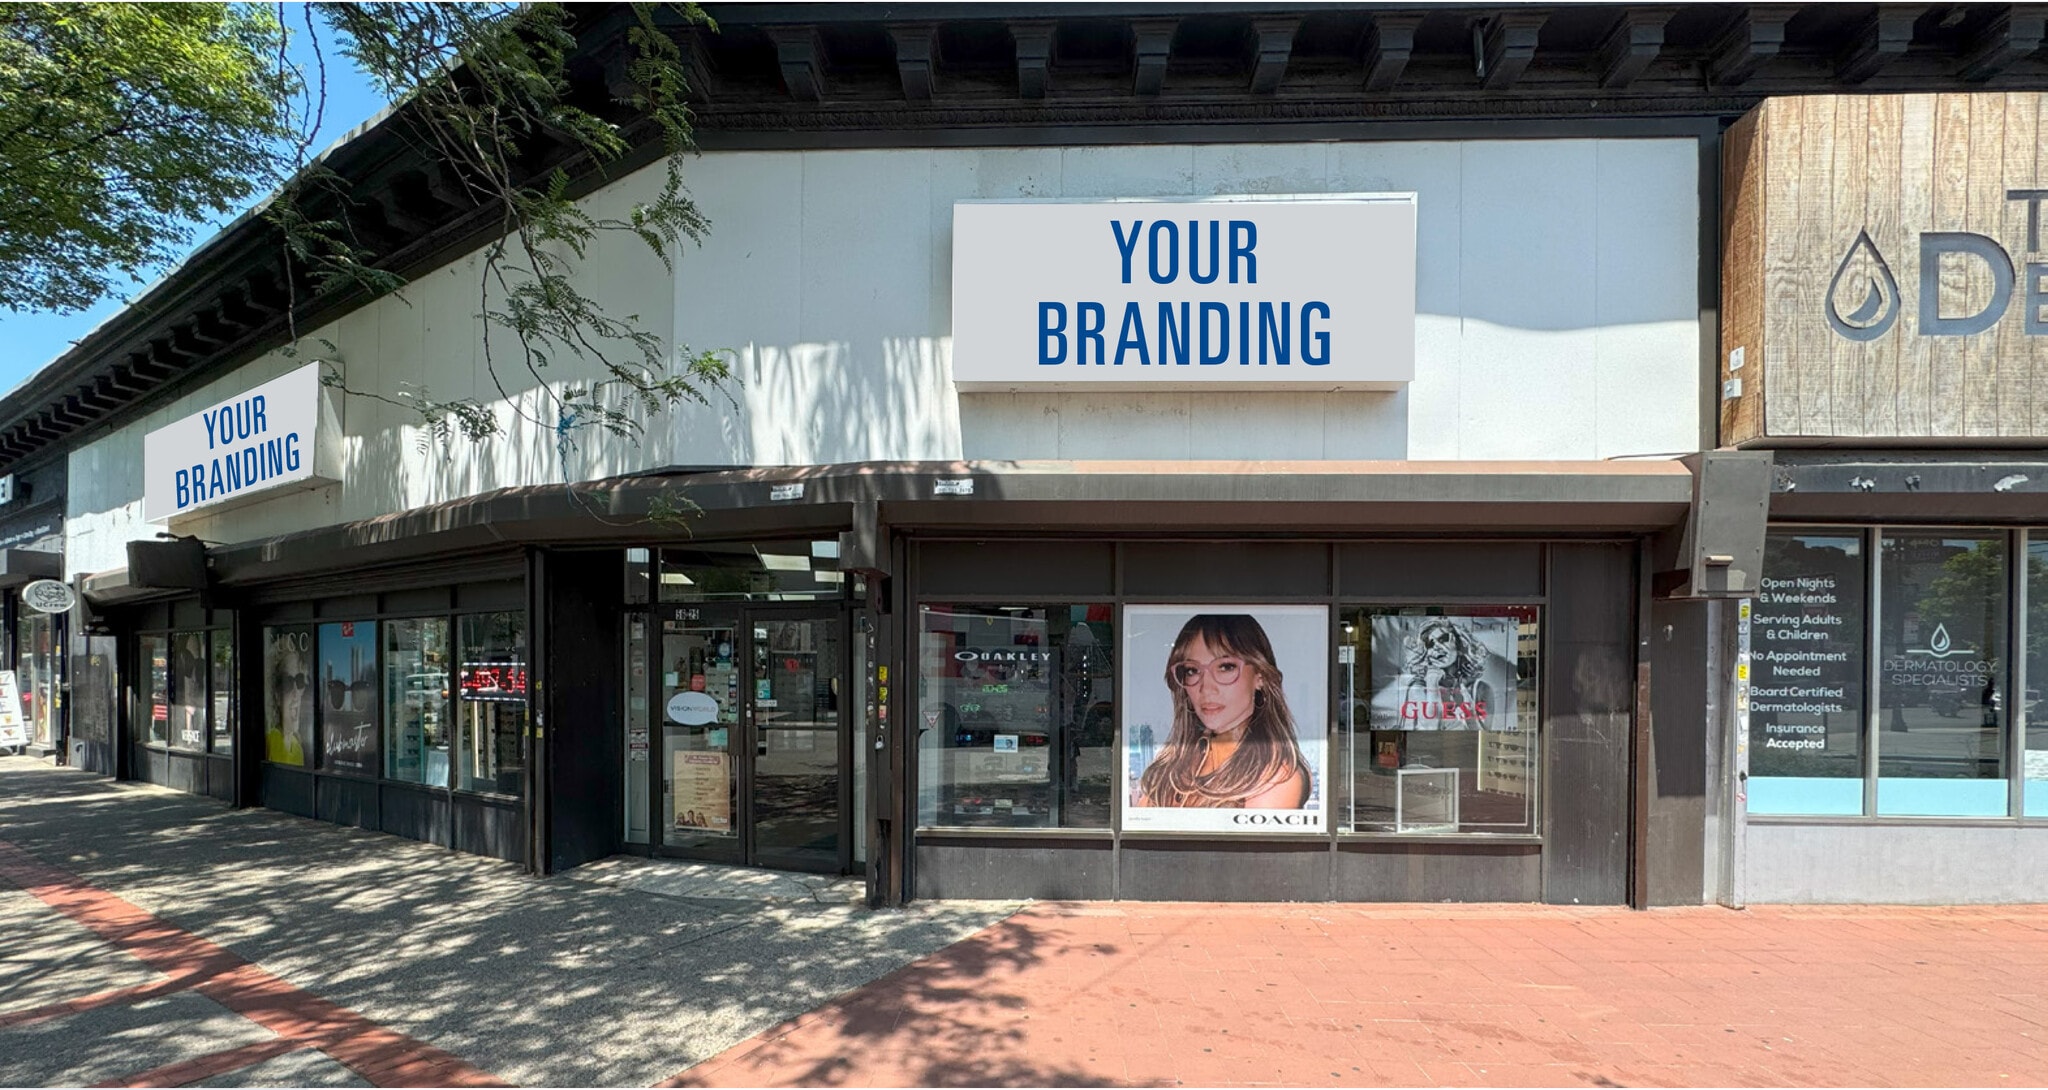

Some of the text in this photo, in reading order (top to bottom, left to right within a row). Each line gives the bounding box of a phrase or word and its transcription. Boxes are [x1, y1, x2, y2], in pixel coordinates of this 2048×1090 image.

[1110, 219, 1258, 285] YOUR
[1038, 301, 1331, 366] BRANDING
[203, 394, 267, 450] YOUR
[175, 432, 300, 509] BRANDING
[1760, 577, 1836, 591] Open Nights
[1759, 592, 1837, 604] & Weekends
[1753, 613, 1842, 628] Serving Adults
[1766, 629, 1829, 640] & Children
[1749, 650, 1847, 663] No Appointment
[1773, 665, 1821, 676] Needed
[1883, 660, 1997, 673] DERMATOLOGY
[1891, 674, 1989, 687] SPECIALISTS
[1750, 686, 1844, 698] Board Certified
[1401, 700, 1489, 721] GUESS
[1750, 701, 1842, 716] Dermatologists
[1766, 722, 1826, 734] Insurance
[1766, 738, 1825, 751] Accepted
[1232, 813, 1319, 826] COACH
